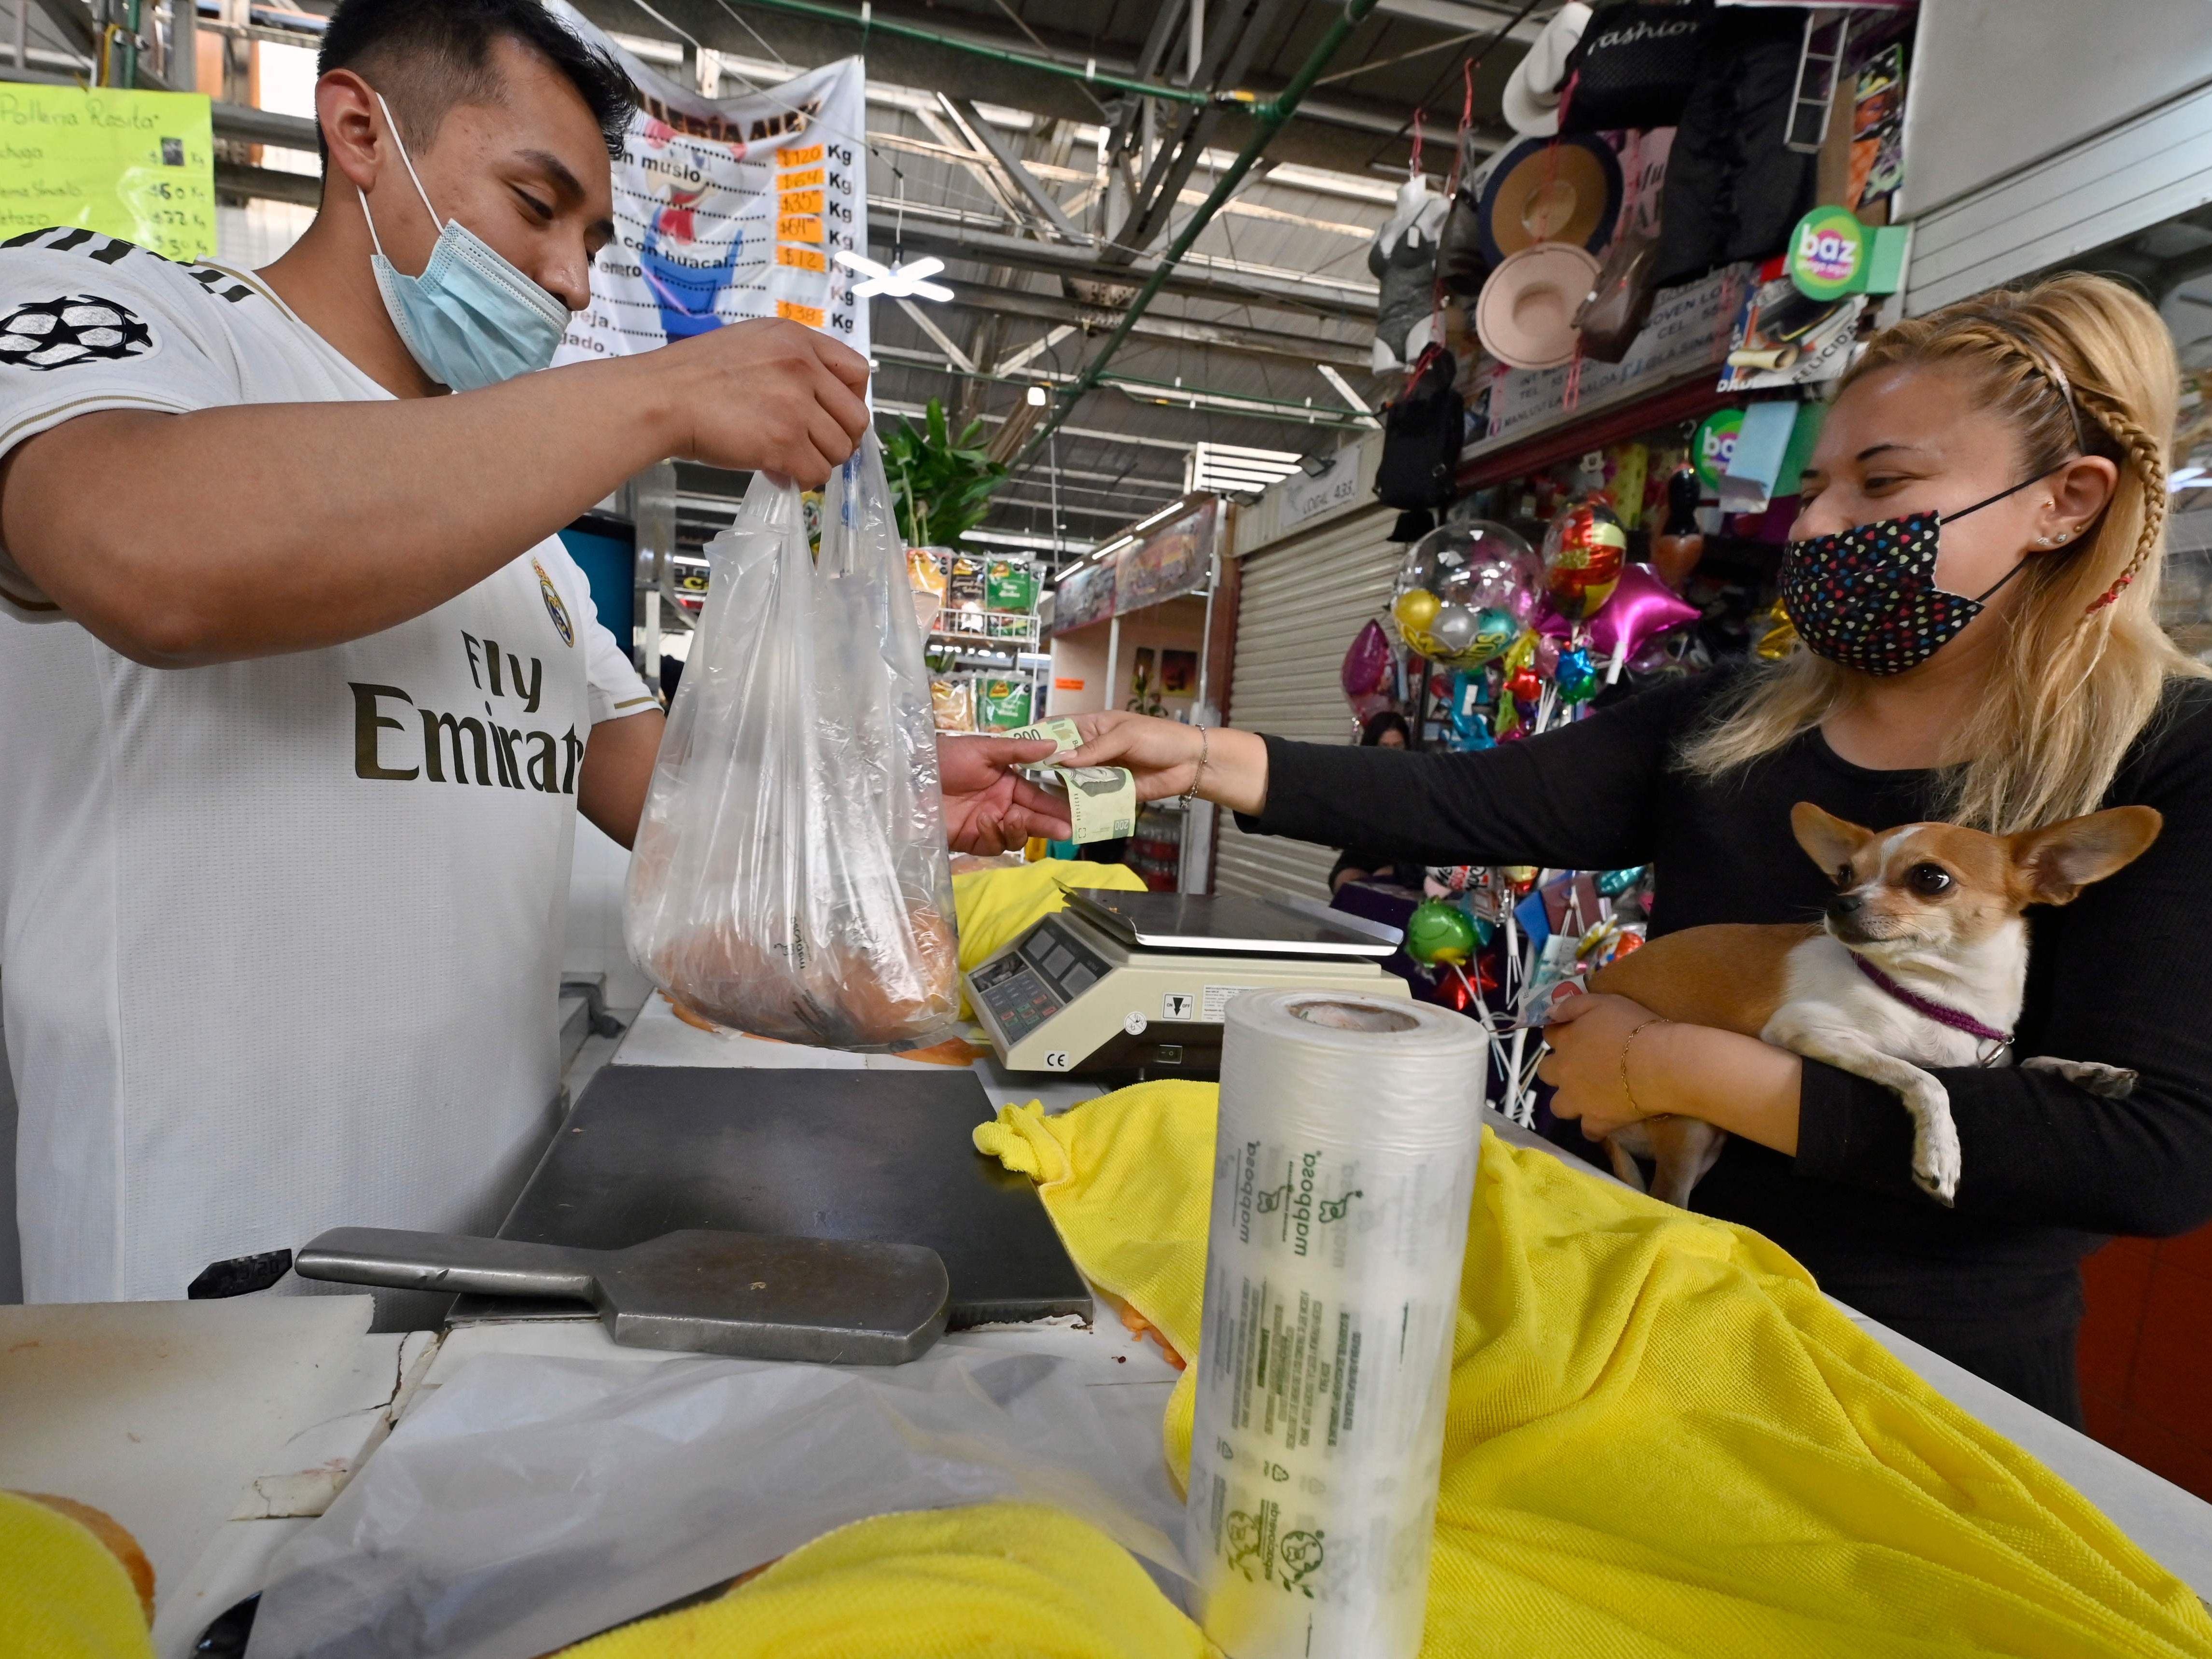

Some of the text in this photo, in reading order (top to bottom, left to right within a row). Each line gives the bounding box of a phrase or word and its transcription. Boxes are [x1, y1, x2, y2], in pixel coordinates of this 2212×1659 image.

[828, 145, 852, 166] Kg
[641, 155, 700, 183] muslo
[829, 172, 852, 195] Kg
[829, 200, 852, 223] Kg
[829, 229, 854, 251] Kg
[1799, 223, 1857, 263] baz
[665, 250, 728, 269] huacal
[830, 285, 854, 307] Kg
[832, 313, 854, 334] Kg
[1703, 426, 1738, 460] ba
[461, 629, 542, 713] Fly
[1115, 820, 1129, 830] 200
[1047, 1053, 1065, 1067] CE
